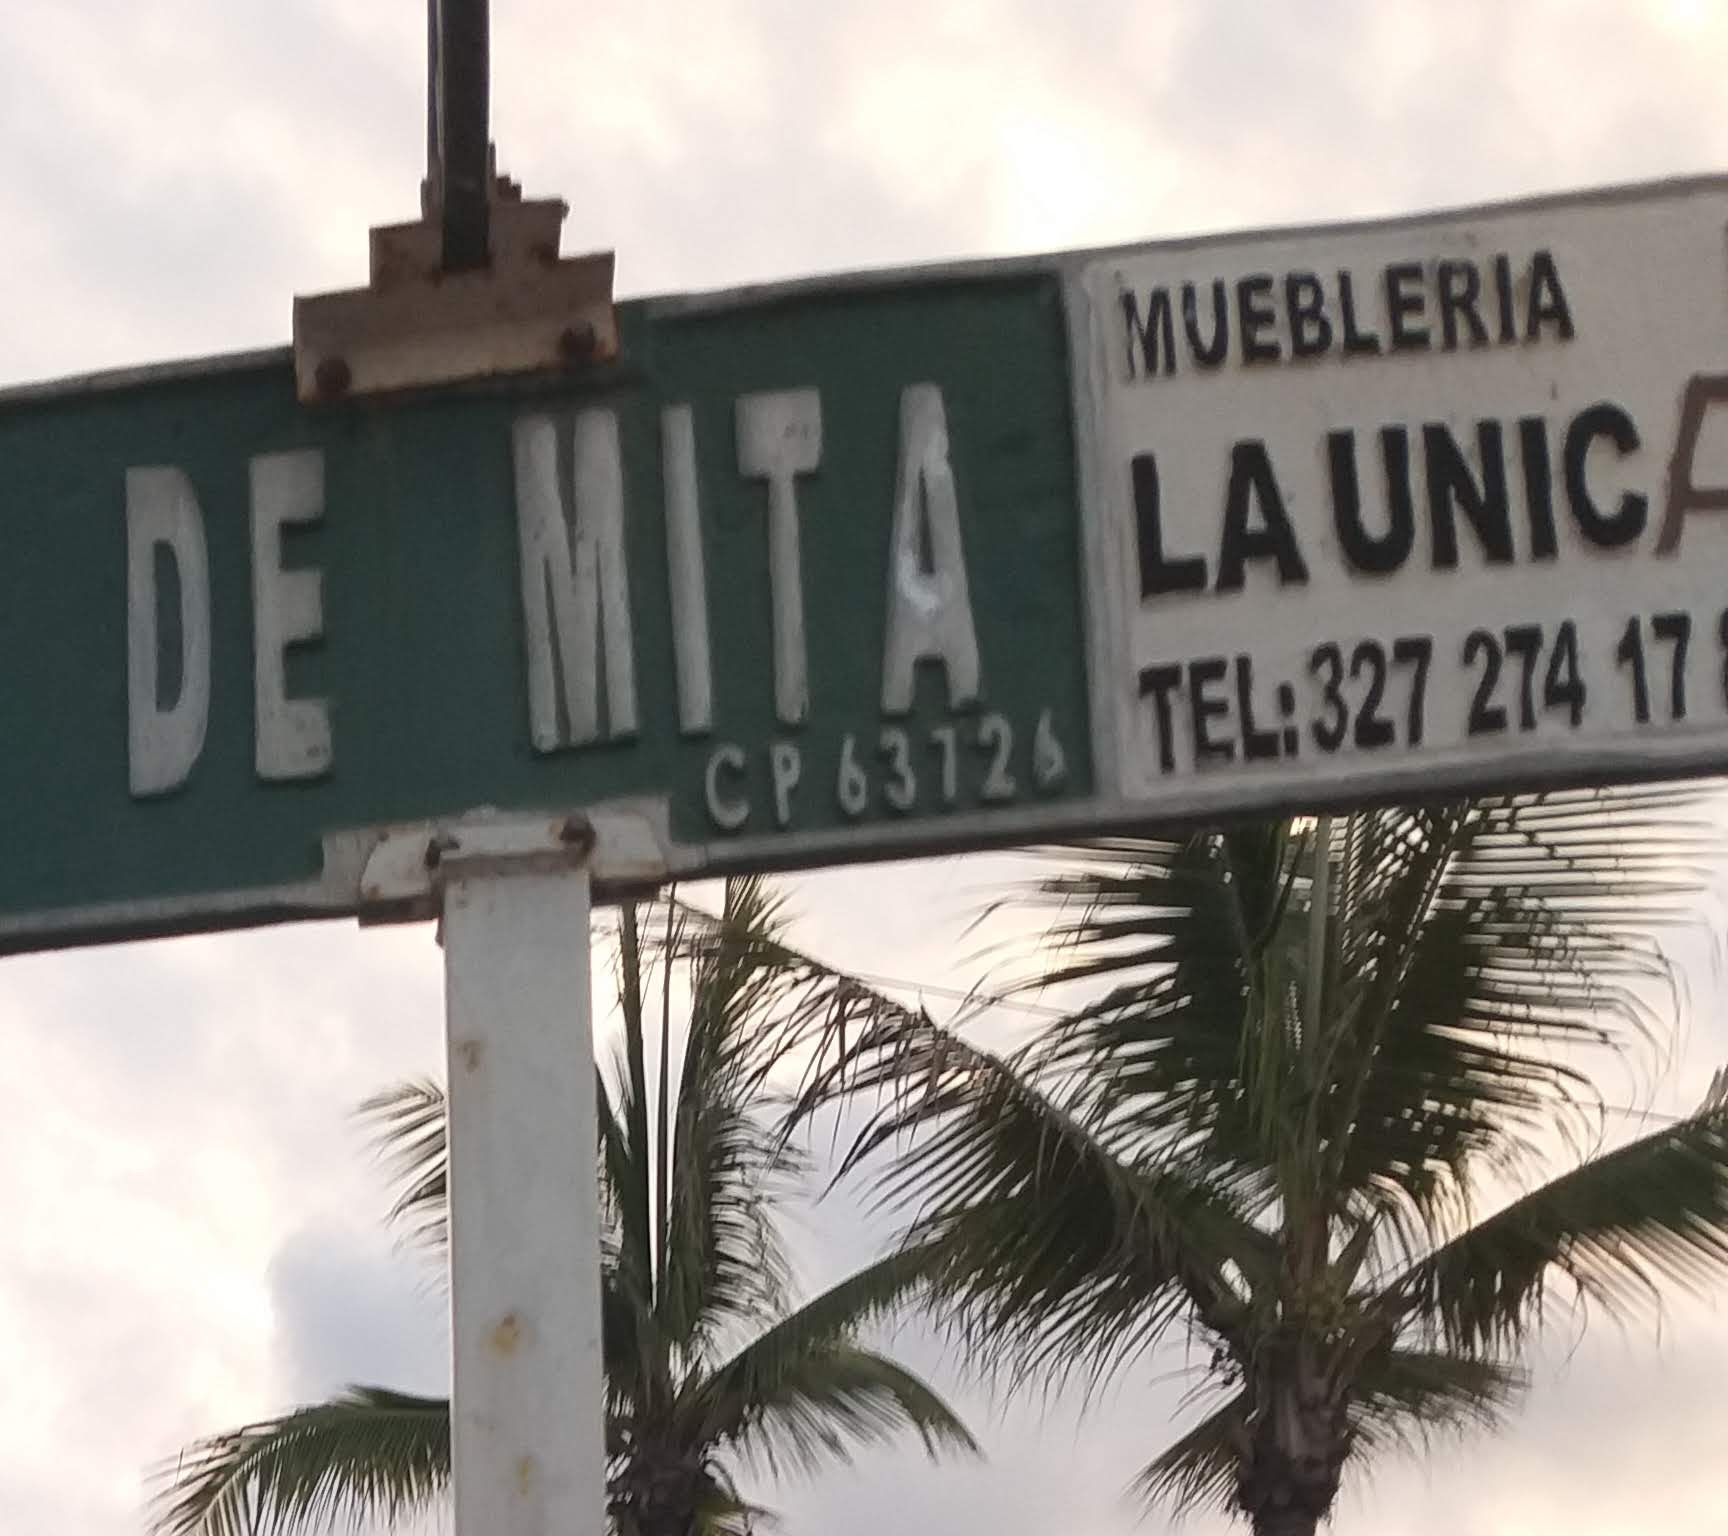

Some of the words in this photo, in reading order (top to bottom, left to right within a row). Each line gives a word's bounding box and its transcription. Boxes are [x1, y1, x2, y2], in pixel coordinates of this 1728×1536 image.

[1118, 249, 1575, 382] MUEBLERIA
[125, 447, 333, 797] DE
[511, 382, 981, 753] MITA
[1131, 438, 1310, 602] LA
[1463, 619, 1588, 736] 274
